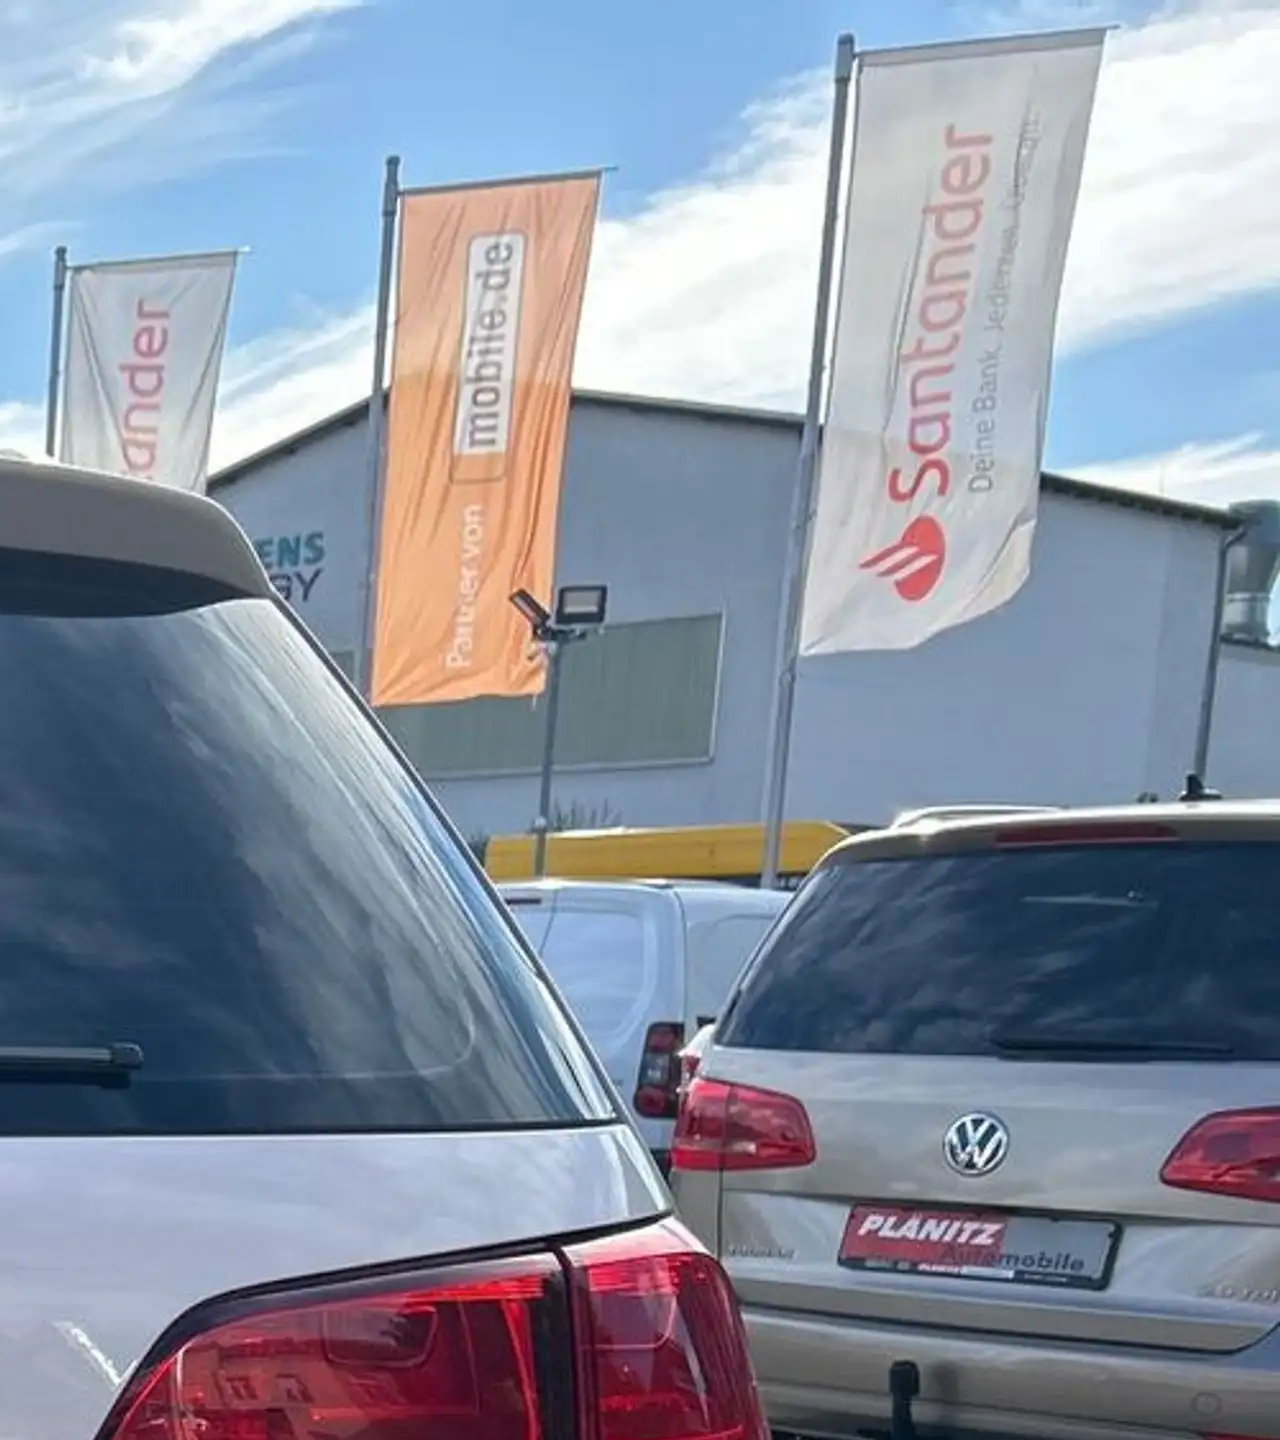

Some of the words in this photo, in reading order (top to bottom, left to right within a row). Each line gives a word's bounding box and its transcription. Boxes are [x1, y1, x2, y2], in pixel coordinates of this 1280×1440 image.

[119, 299, 171, 479] ander
[466, 239, 514, 449] mobile.de
[889, 122, 993, 502] Santander
[462, 505, 482, 559] von
[968, 419, 995, 493] Deine
